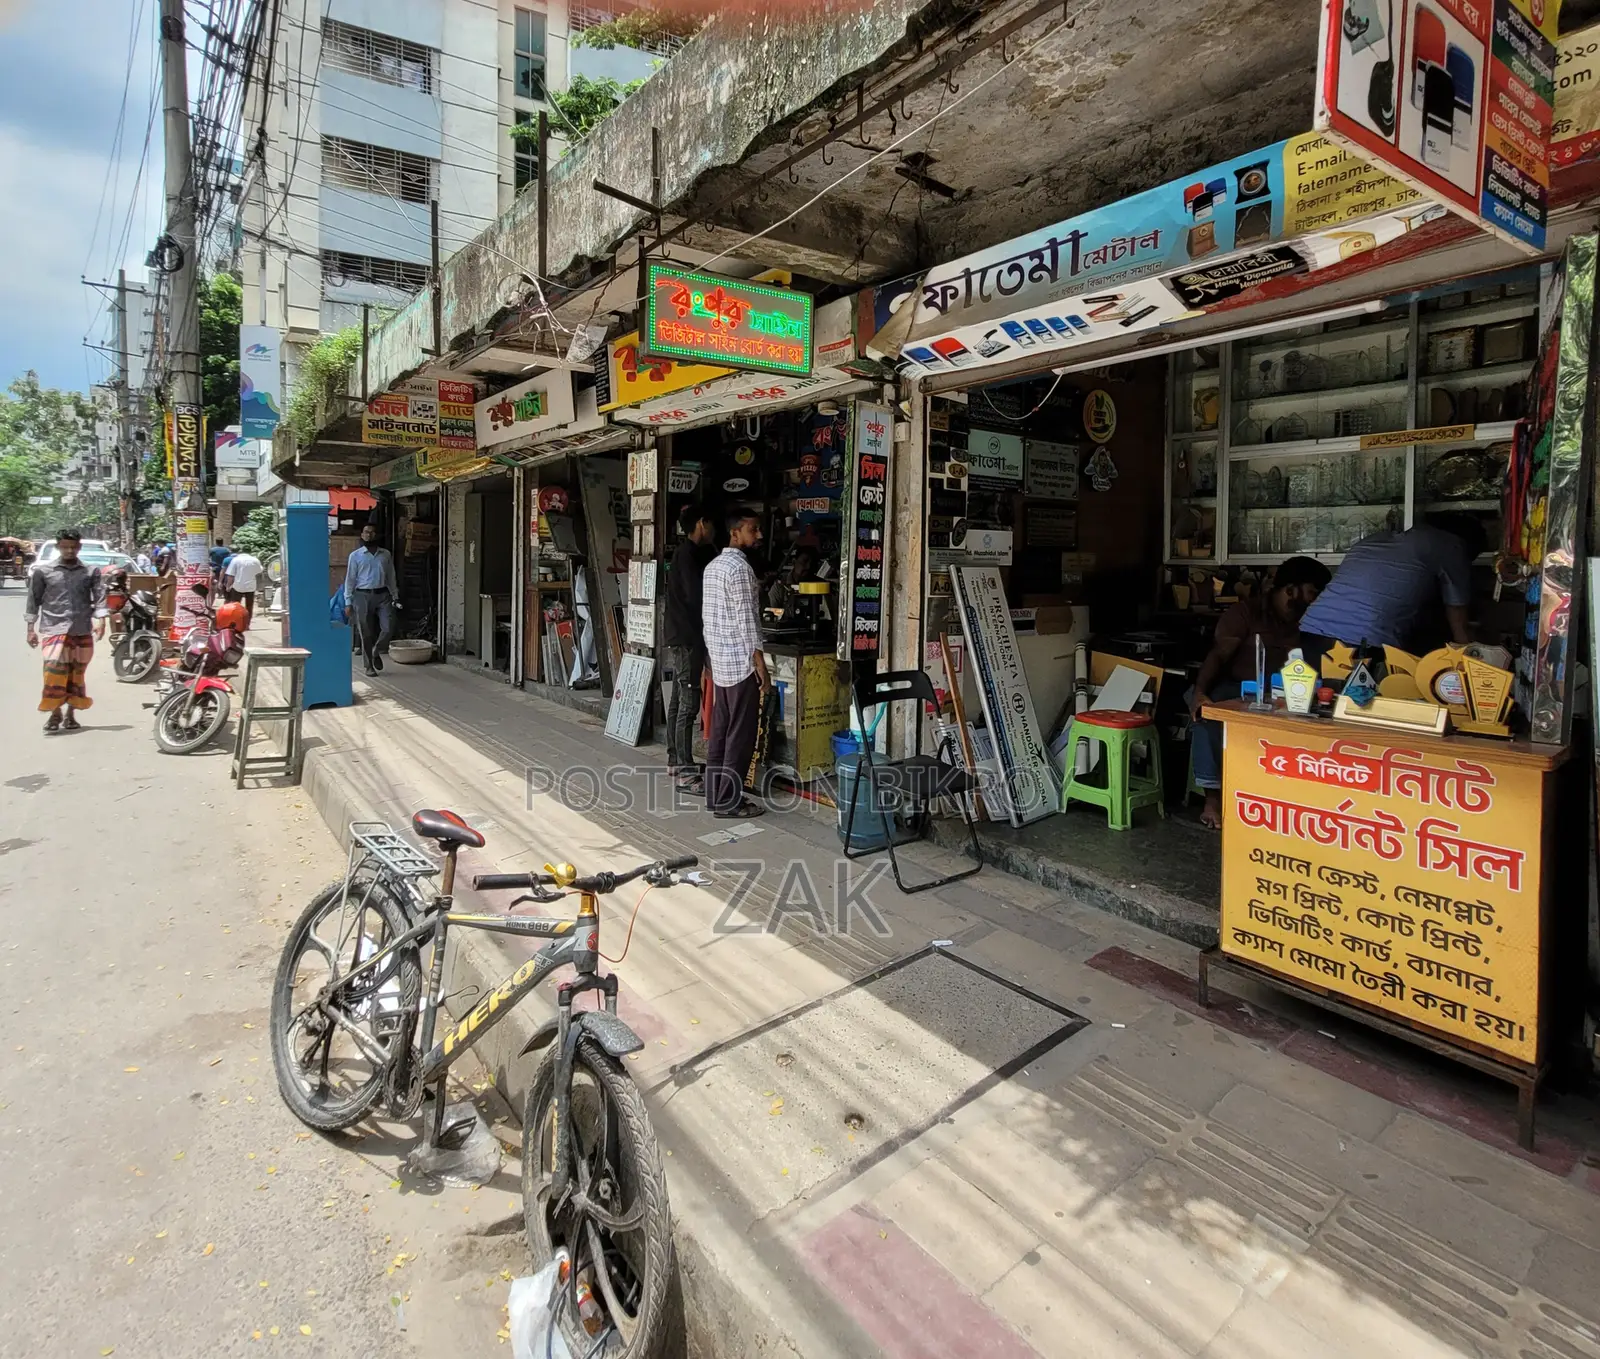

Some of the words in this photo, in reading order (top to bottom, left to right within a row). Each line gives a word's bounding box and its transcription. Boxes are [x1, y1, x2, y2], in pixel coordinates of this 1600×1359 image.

[1297, 163, 1378, 195] fatemame
[1298, 150, 1348, 176] E-mail
[922, 230, 1088, 315] ফাতেমা
[1082, 229, 1163, 270] মেটাল
[748, 309, 804, 340] সাইন
[367, 416, 438, 435] সাইনবোর্ড
[441, 404, 474, 417] প্যাড
[239, 449, 257, 457] MTB
[861, 455, 885, 481] সিল
[860, 482, 884, 505] ক্রেস্ট
[988, 605, 1009, 671] INTERNATIONAL
[991, 596, 1019, 678] PROCHESTA
[1019, 714, 1038, 768] HANDOVER
[1034, 769, 1048, 807] GLOBAL
[1271, 756, 1287, 772] ৫
[1296, 754, 1373, 784] মিনিটে
[1234, 790, 1407, 861] আর্জেন্ট
[1414, 816, 1526, 892] সিল
[1249, 848, 1311, 878] এখানে
[1256, 877, 1287, 901] মগ
[1357, 905, 1414, 939] কোট
[1248, 900, 1333, 942] ভিজিটিং
[1405, 952, 1502, 1003] ব্যানার,
[1232, 926, 1284, 959] ক্যাশ
[1290, 947, 1346, 980] মেমো
[1352, 961, 1404, 1001] তৈরী
[1411, 987, 1468, 1023] করা
[443, 959, 537, 1056] HERO
